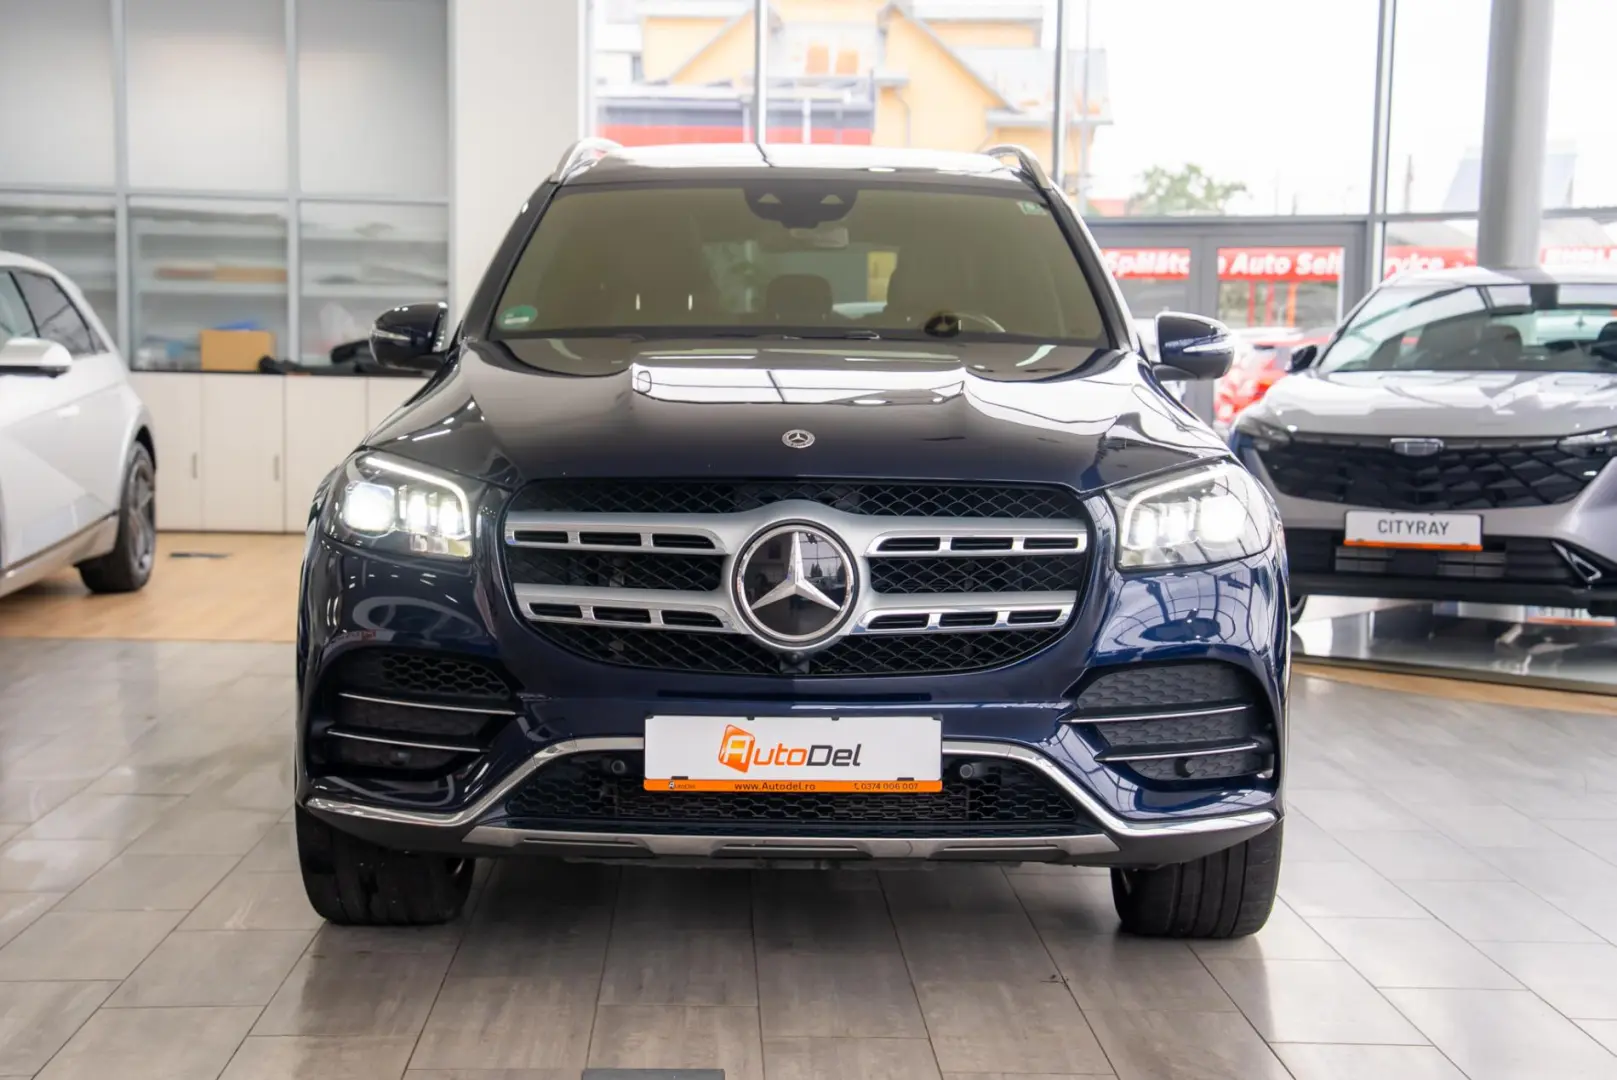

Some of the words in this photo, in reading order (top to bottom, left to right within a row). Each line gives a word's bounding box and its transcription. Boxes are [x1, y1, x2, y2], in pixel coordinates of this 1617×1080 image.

[1229, 251, 1292, 275] Auto
[1377, 519, 1449, 536] CITYRAY
[718, 724, 862, 773] AutoDel
[734, 782, 816, 791] www.Autodel.ro
[860, 782, 881, 790] 0374
[883, 782, 900, 790] 006
[902, 782, 918, 790] 007
